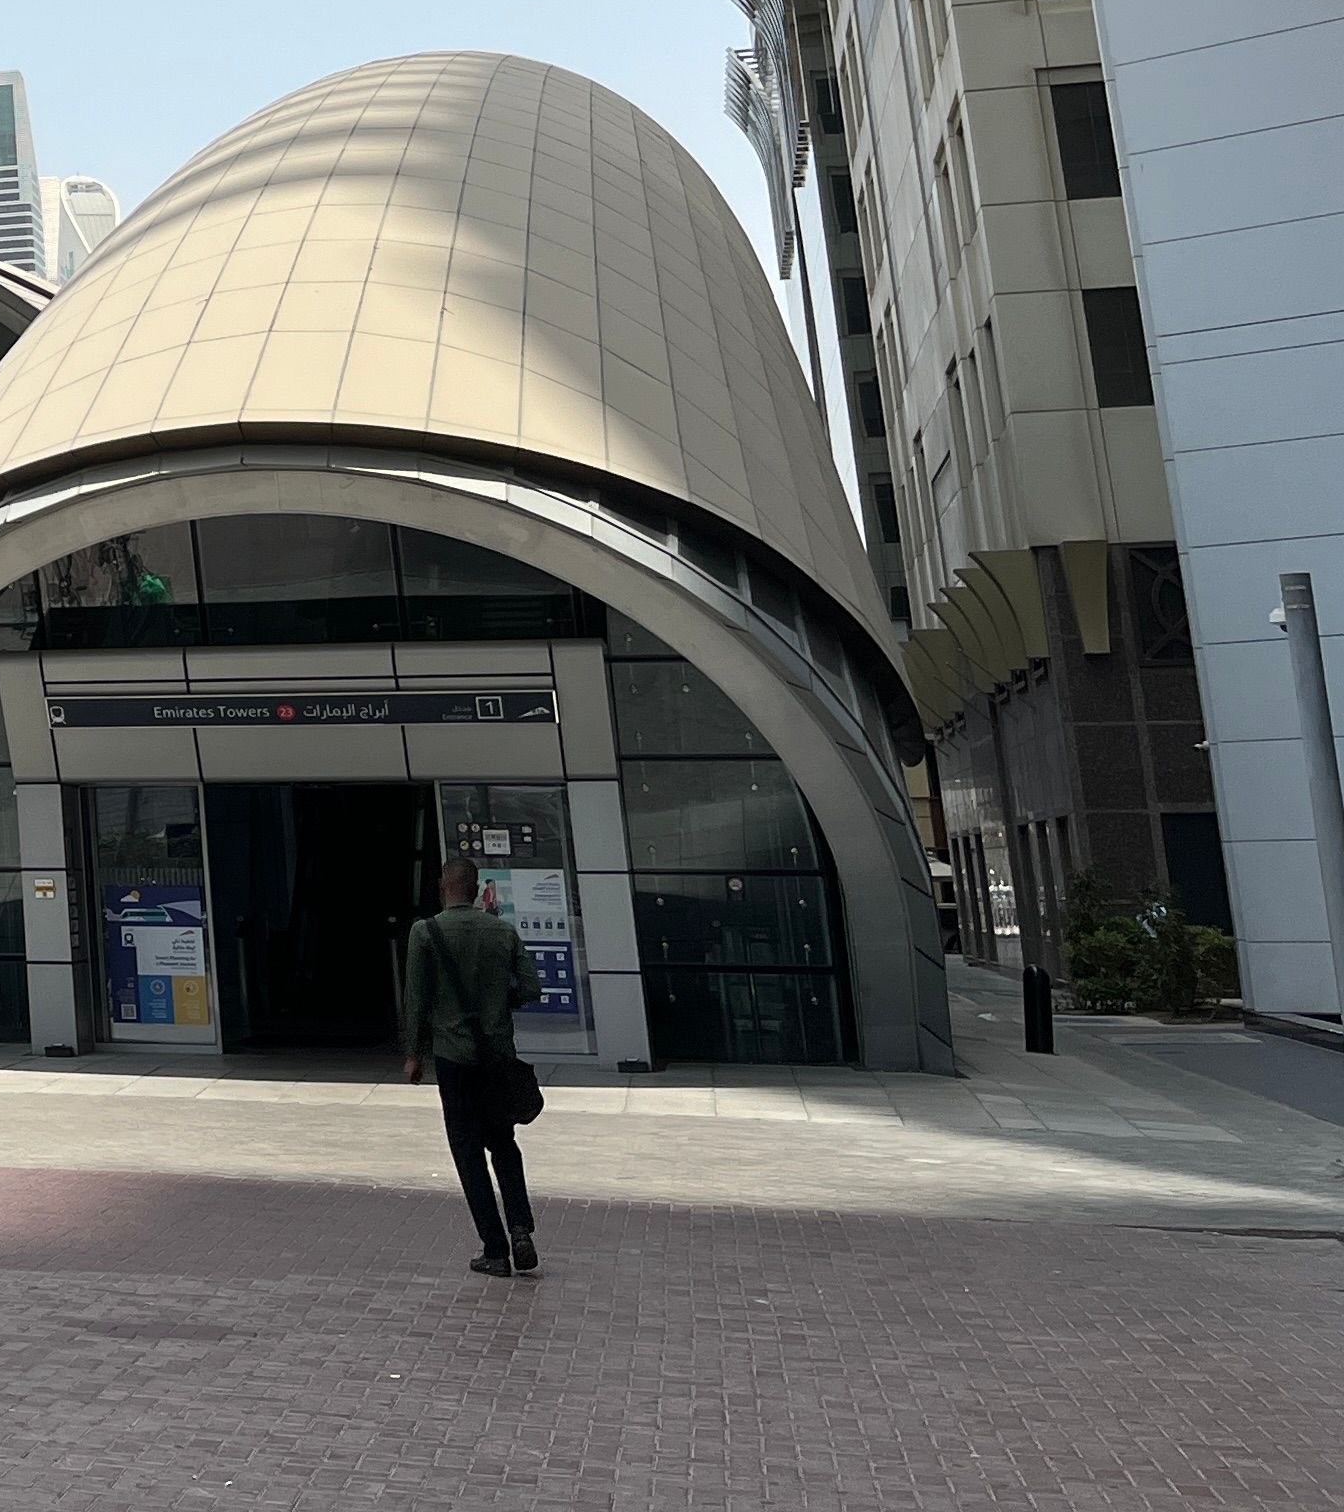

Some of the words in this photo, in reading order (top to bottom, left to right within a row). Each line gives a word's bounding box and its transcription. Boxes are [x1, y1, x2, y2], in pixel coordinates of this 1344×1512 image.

[153, 705, 215, 719] Emirates
[217, 705, 270, 718] Towers
[280, 709, 293, 718] 23
[303, 702, 356, 720] الإمارات
[359, 699, 390, 720] أبراج
[485, 700, 494, 715] 1
